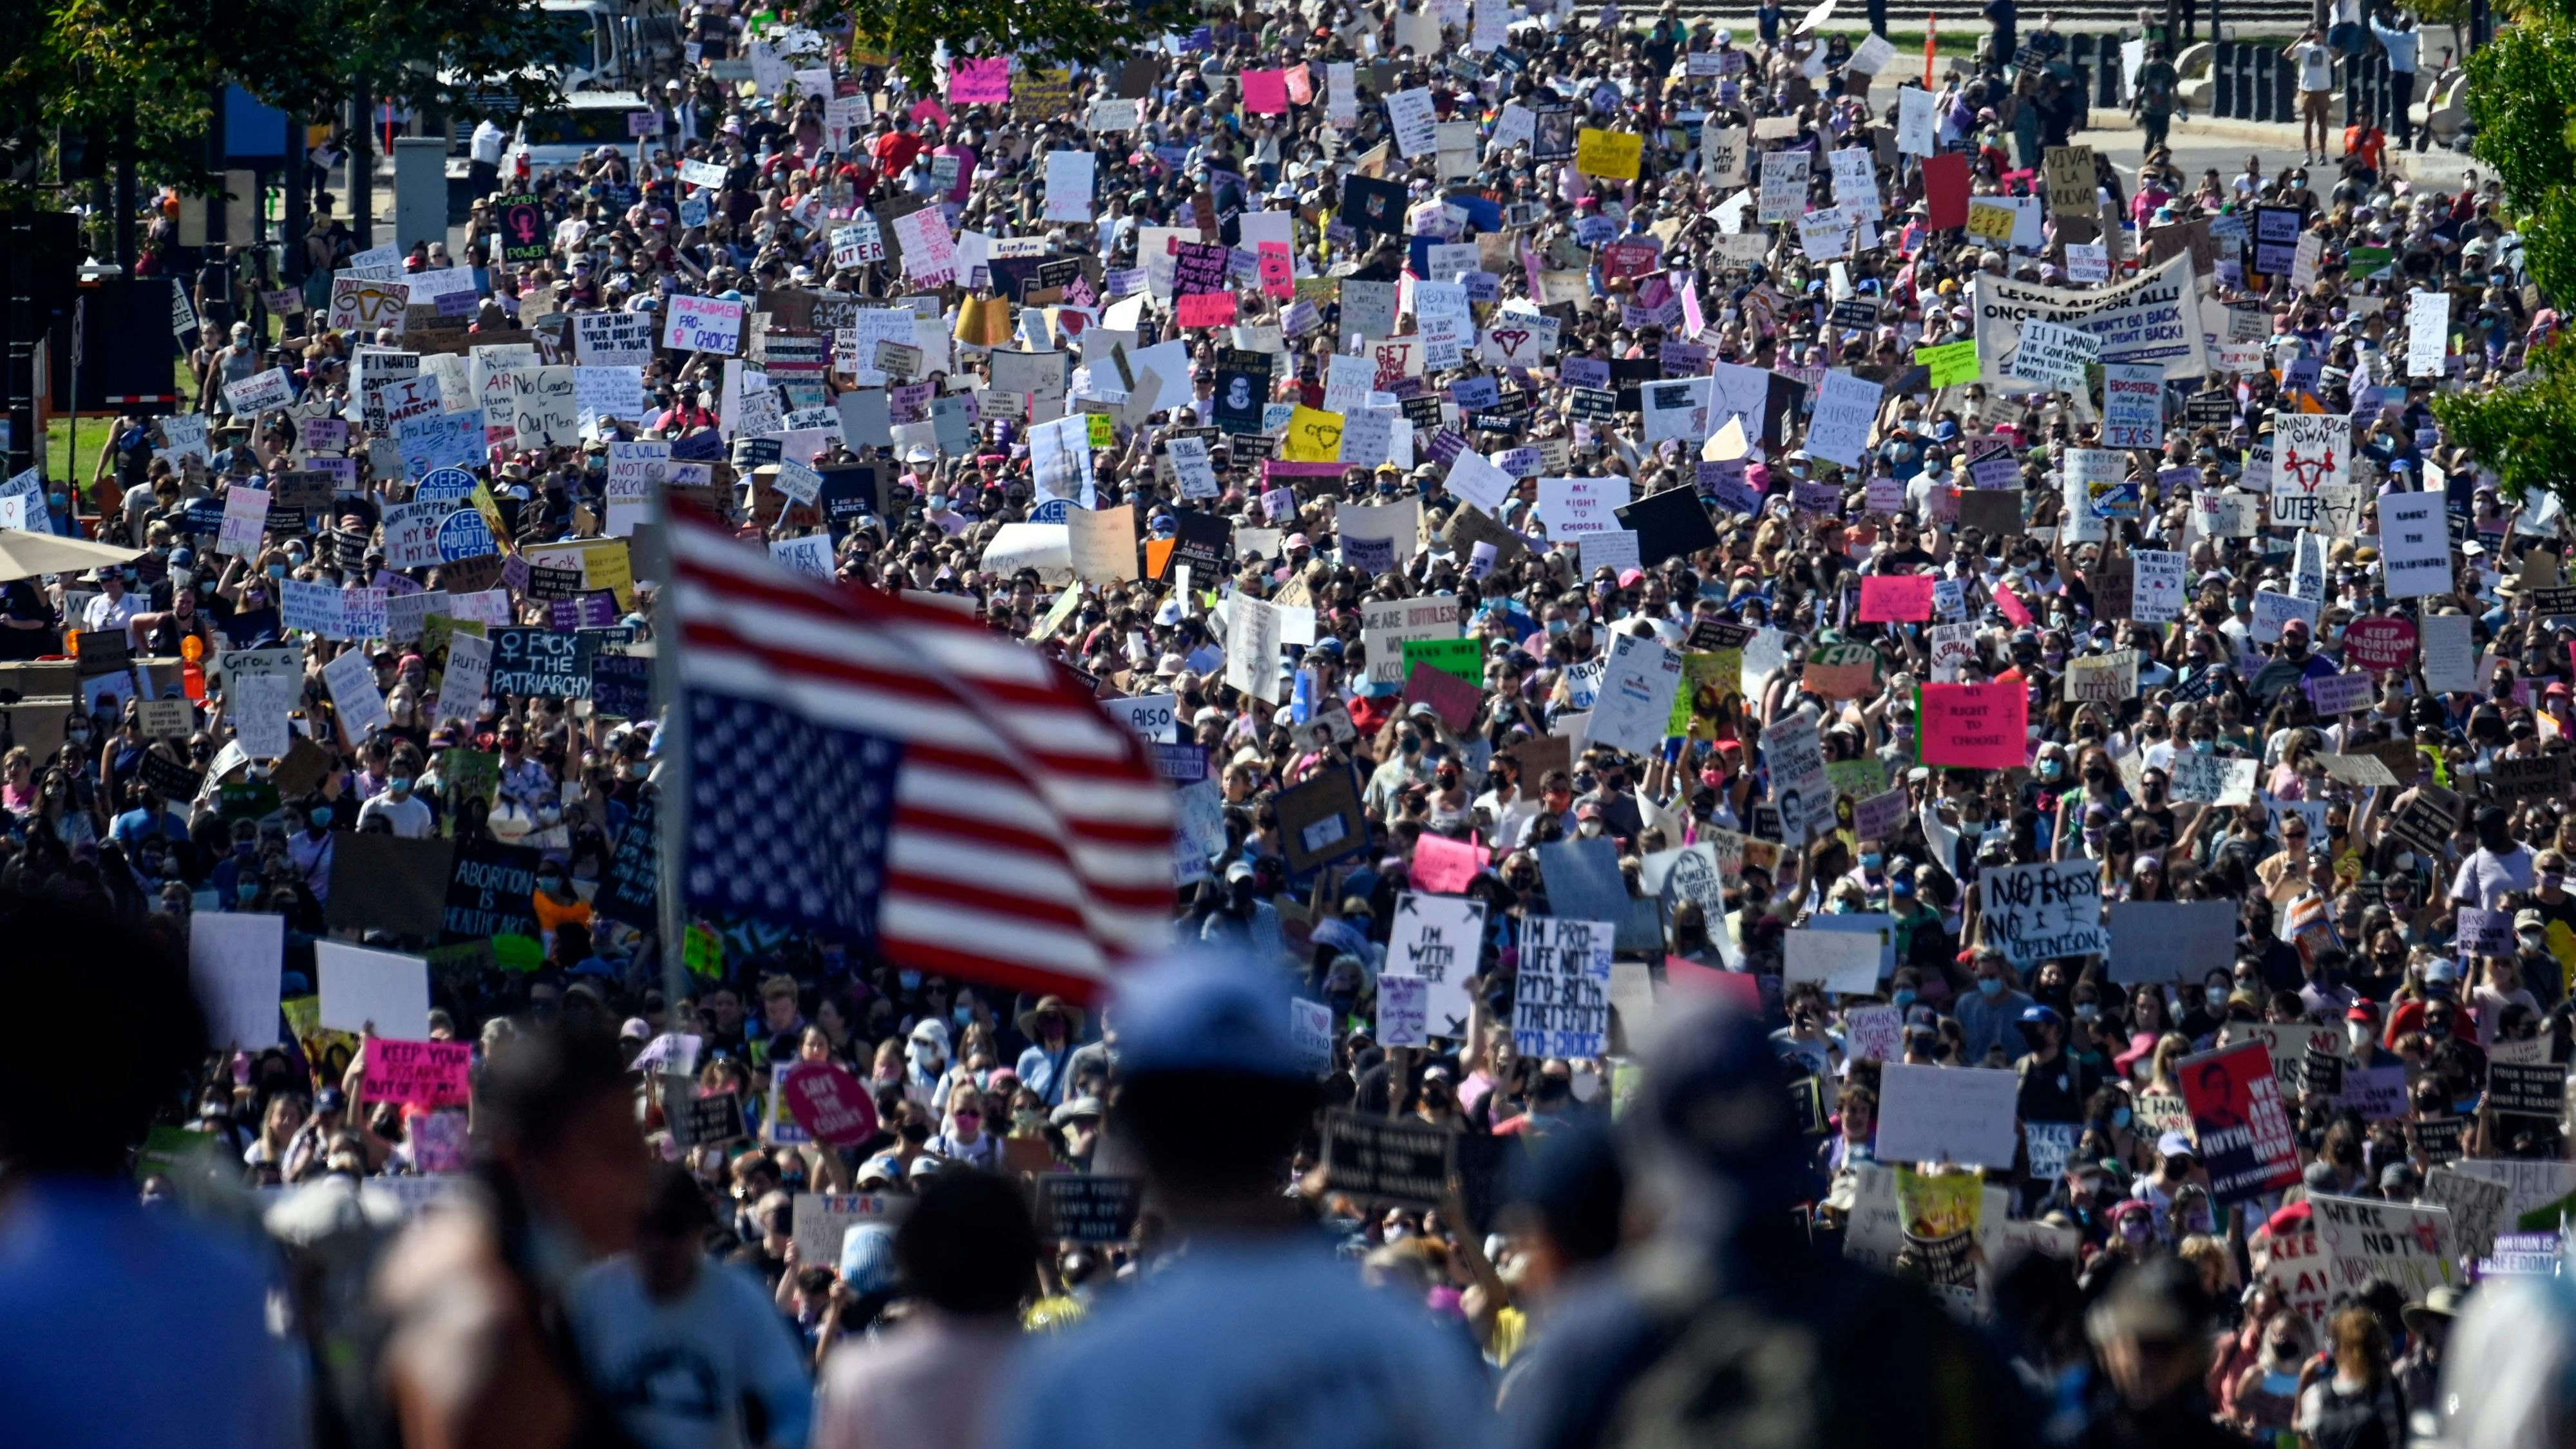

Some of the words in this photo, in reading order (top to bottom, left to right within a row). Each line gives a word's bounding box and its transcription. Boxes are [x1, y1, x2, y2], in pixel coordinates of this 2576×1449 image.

[2048, 149, 2090, 167] VIVA
[2062, 171, 2079, 184] LA
[498, 194, 539, 206] WOMEN
[507, 245, 545, 258] POWER
[674, 298, 741, 319] PRO-WOMEN
[1985, 305, 2038, 321] ONCE
[2096, 298, 2132, 314] FOR
[2139, 287, 2179, 305] ALL!
[2128, 316, 2143, 327] GO
[2147, 308, 2182, 323] BACK
[694, 330, 737, 352] CHOICE
[2111, 332, 2139, 345] FIGHT
[2146, 325, 2184, 340] BACK!
[1376, 345, 1411, 360] GET
[361, 355, 371, 369] IF
[375, 355, 379, 369] I
[386, 355, 419, 368] WANTED
[514, 374, 534, 395] No
[401, 383, 421, 405] I
[388, 399, 438, 424] MARCH
[518, 412, 540, 435] Old
[545, 412, 574, 430] Men
[2276, 416, 2311, 434] MIND
[2320, 417, 2350, 434] YOUR
[2110, 426, 2153, 444] TEXAS
[2293, 428, 2329, 444] OWN
[613, 444, 630, 458] WE
[638, 444, 667, 457] WILL
[615, 463, 639, 476] NOT
[645, 463, 665, 477] GO
[429, 473, 469, 486] KEEP
[1572, 484, 1587, 493] MY
[1566, 499, 1596, 507] RIGHT
[2197, 495, 2219, 514] SHE
[2275, 497, 2318, 520] UTER
[403, 530, 419, 543] MY
[406, 547, 421, 562] MY
[1382, 612, 1401, 628] ARE
[2364, 626, 2399, 639] KEEP
[2344, 638, 2414, 656] ABORTION
[2358, 649, 2396, 662] LEGAL
[452, 652, 492, 673] RUTH
[530, 656, 573, 672] THE
[493, 670, 591, 698] PATRIARCHY
[1951, 706, 1989, 716] RIGHT
[455, 860, 533, 892] ABORTION
[1992, 871, 2034, 907] NO
[480, 891, 495, 909] IS
[2459, 915, 2485, 925] BANS
[2460, 927, 2477, 937] OFF
[2479, 929, 2505, 940] OUR
[1408, 943, 1454, 966] WITH
[1520, 945, 1552, 971] LIFE
[381, 1046, 422, 1062] KEEP
[430, 1048, 467, 1065] YOUR
[2493, 1067, 2519, 1080] YOUR
[2523, 1069, 2562, 1081] REASON
[798, 1075, 838, 1095] SAVE
[2249, 1076, 2276, 1097] WE
[2524, 1083, 2544, 1093] THE
[2249, 1097, 2280, 1119] ARE
[2255, 1141, 2290, 1162] NOW
[821, 1197, 884, 1213] TEXAS
[2362, 1233, 2410, 1256] NOT
